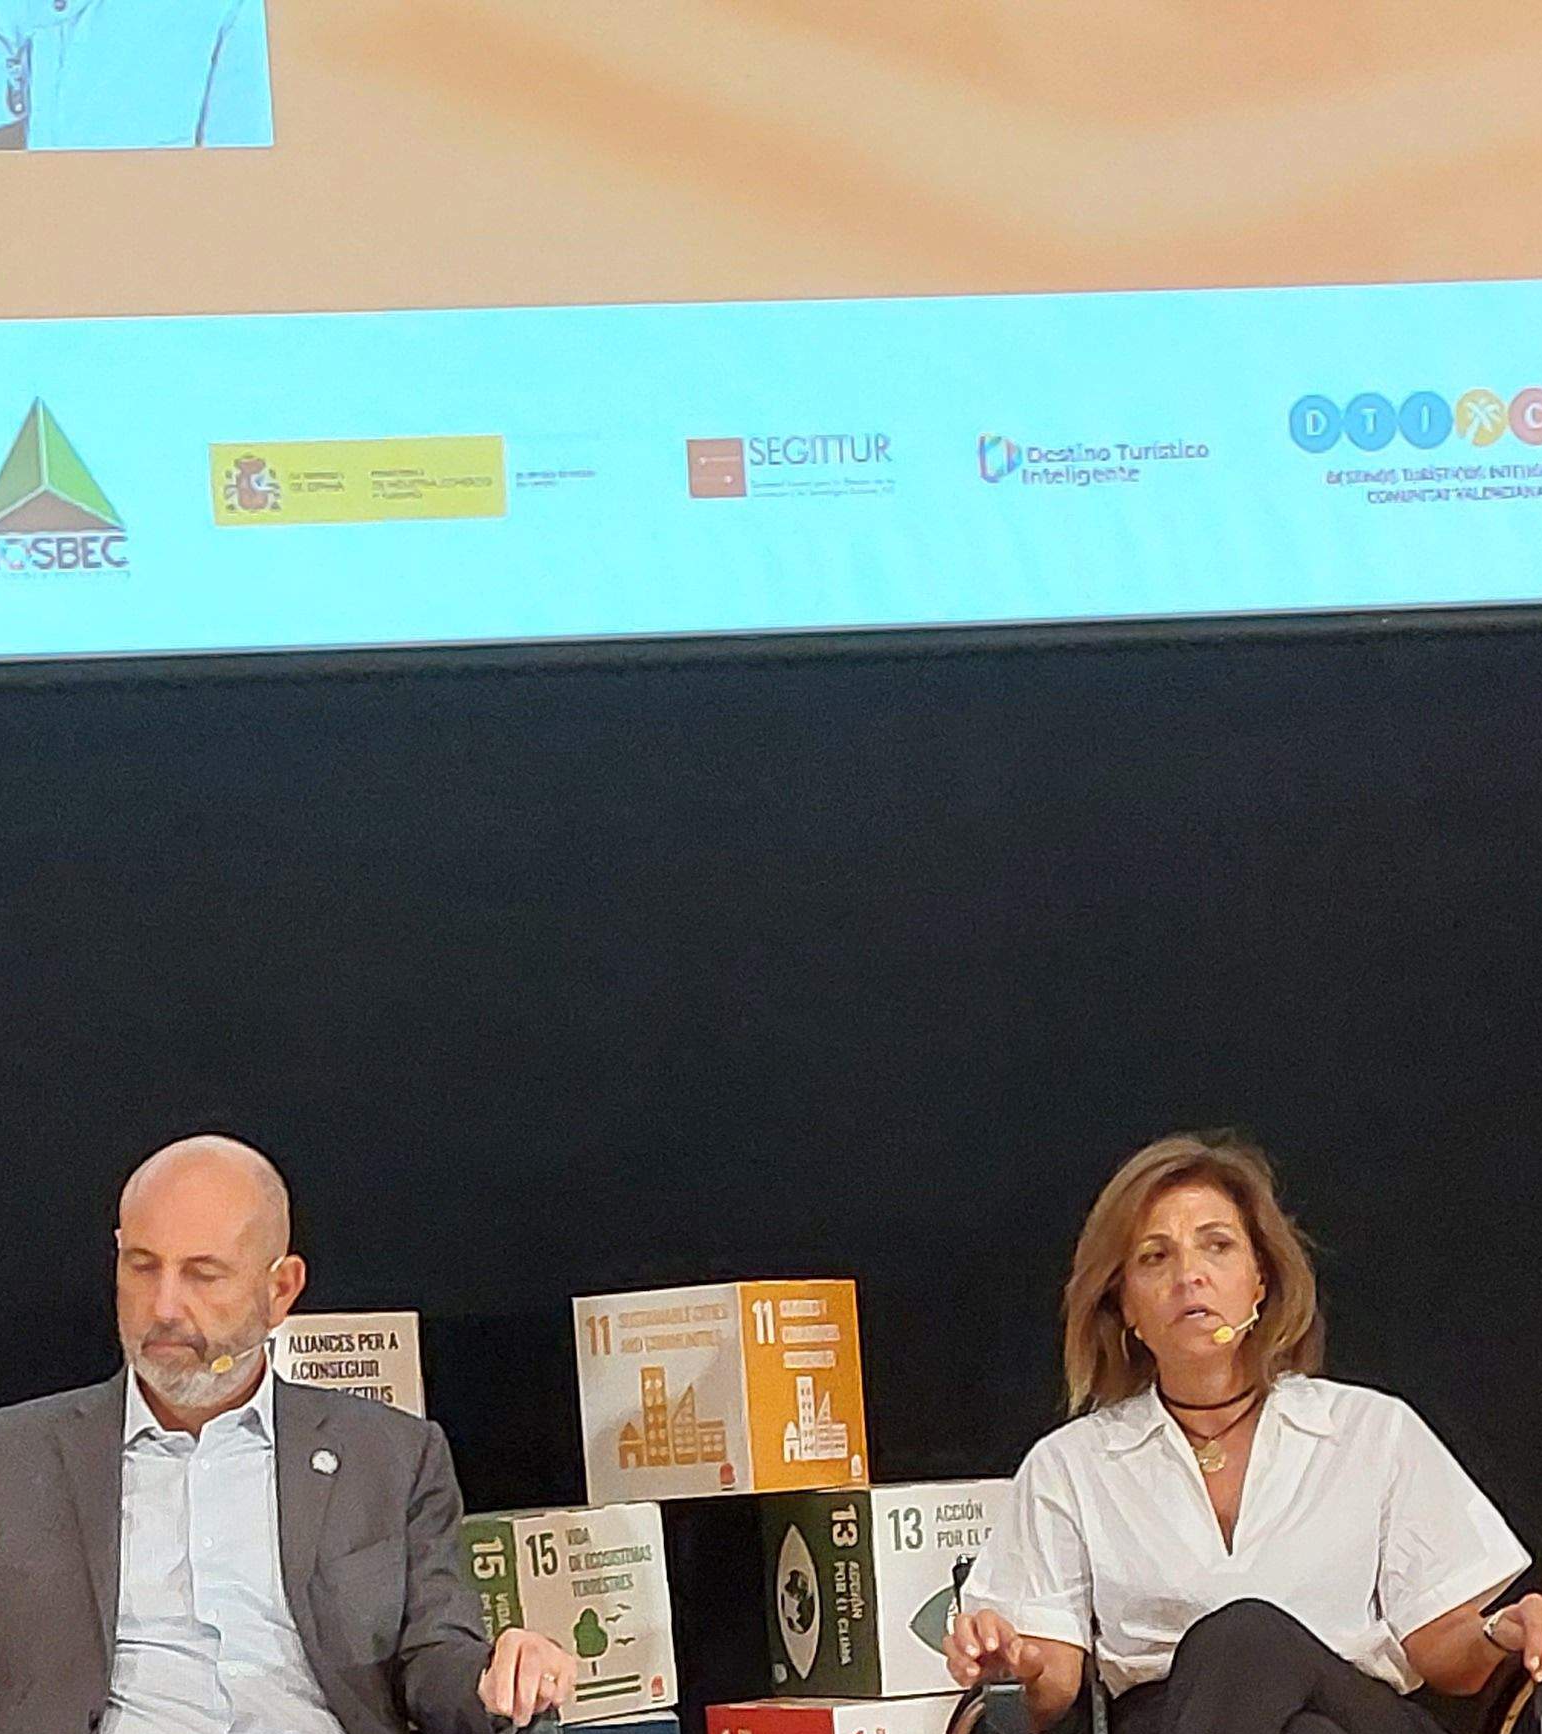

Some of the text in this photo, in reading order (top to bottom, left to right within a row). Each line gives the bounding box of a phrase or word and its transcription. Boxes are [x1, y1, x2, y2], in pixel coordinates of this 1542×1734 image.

[749, 432, 893, 466] SEGITTUR
[1027, 438, 1210, 464] Destino Turístico
[1022, 464, 1140, 487] Inteligente
[358, 1333, 385, 1352] PER
[388, 1331, 399, 1350] A
[587, 1314, 612, 1356] 11
[751, 1298, 775, 1345] 11
[831, 1503, 859, 1547] 13
[887, 1507, 924, 1551] 13
[936, 1498, 983, 1523] ACCIÓN
[471, 1536, 507, 1580] 15
[526, 1532, 558, 1578] 15
